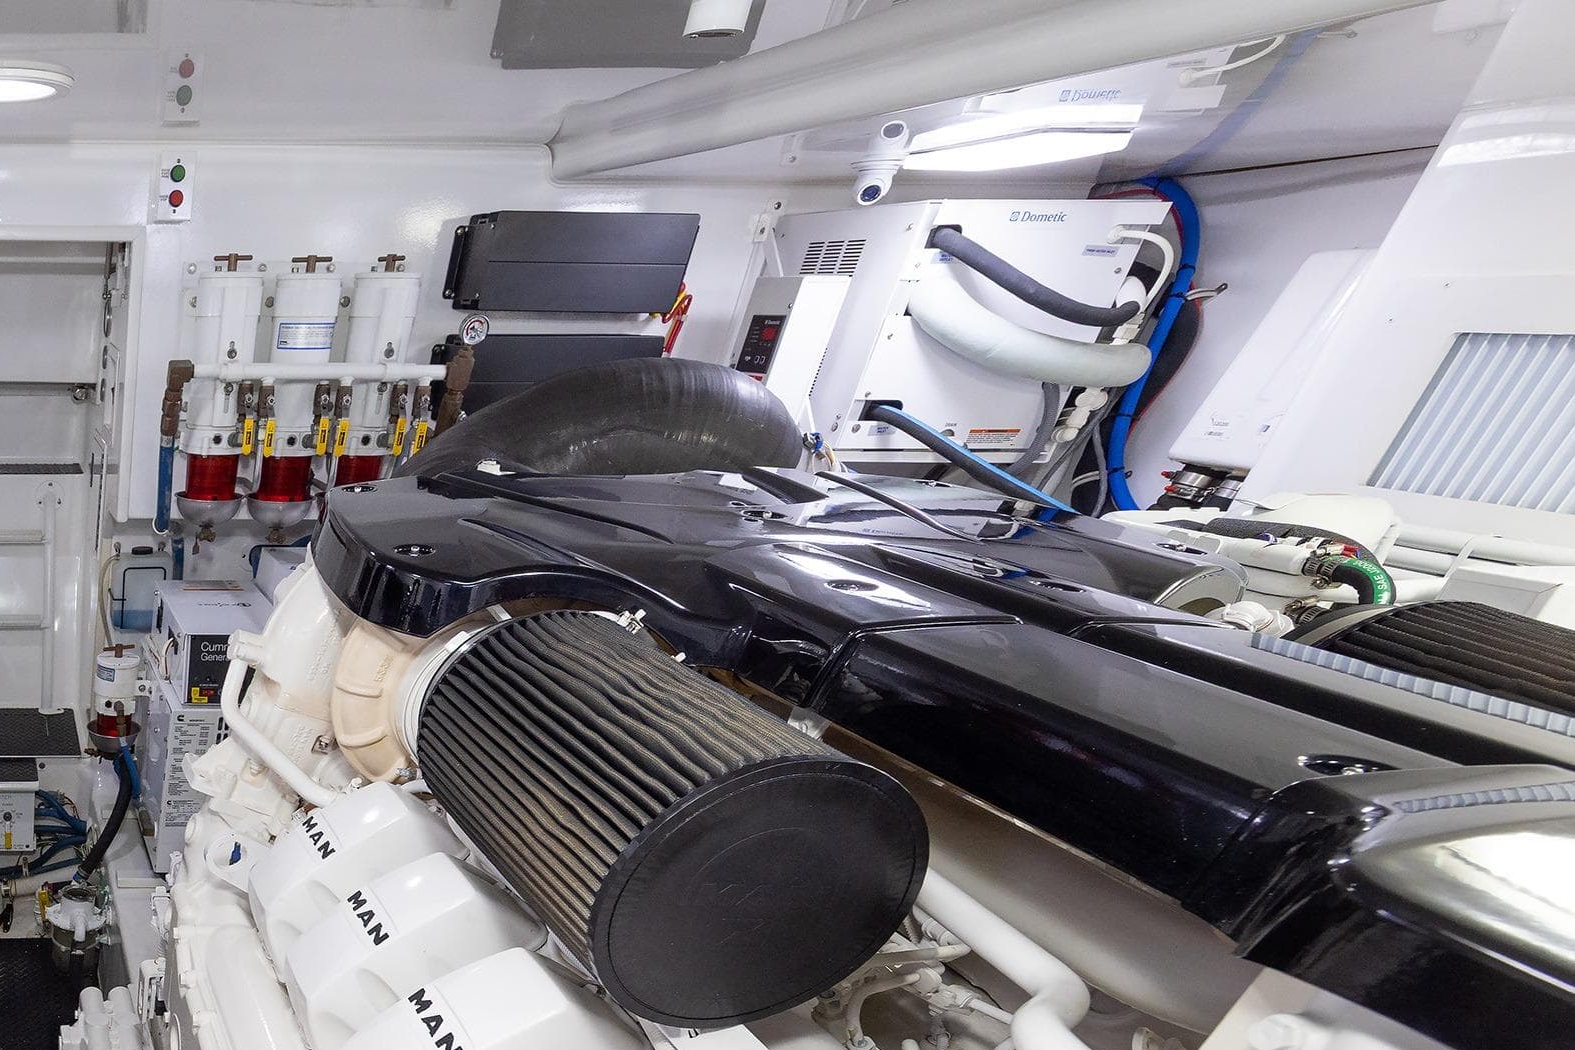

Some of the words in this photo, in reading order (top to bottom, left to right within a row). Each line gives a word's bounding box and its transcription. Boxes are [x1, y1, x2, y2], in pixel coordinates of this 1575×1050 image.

[1020, 211, 1067, 222] Dometic
[1374, 573, 1387, 590] SAE
[302, 815, 336, 860] MAN
[346, 890, 390, 946] MAN
